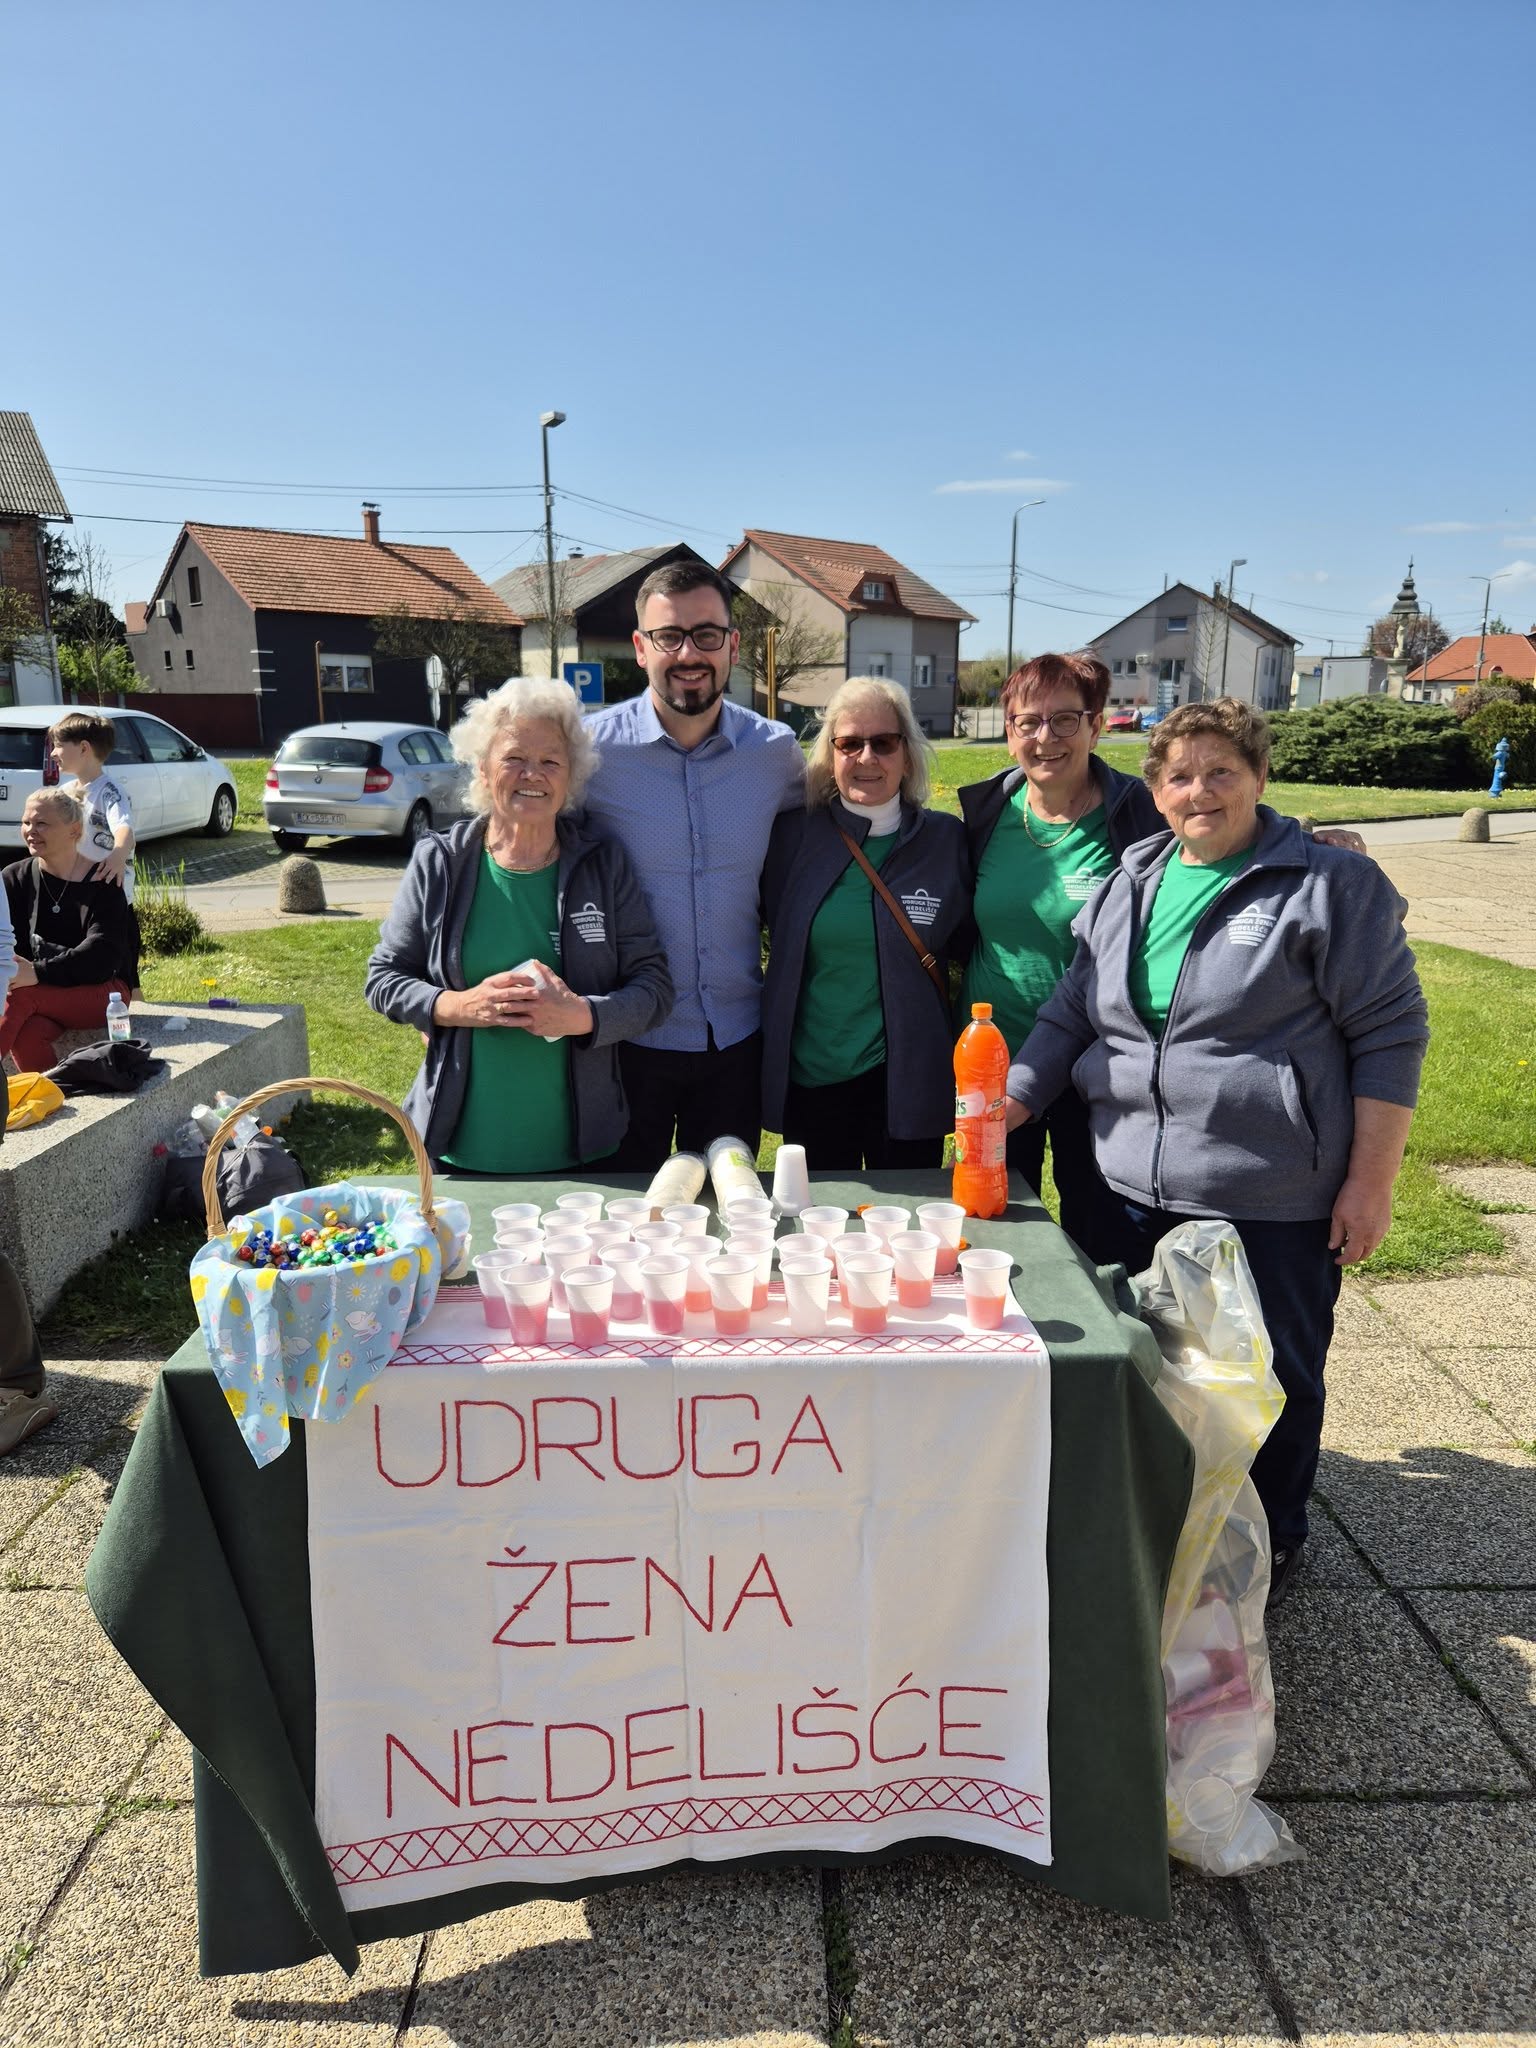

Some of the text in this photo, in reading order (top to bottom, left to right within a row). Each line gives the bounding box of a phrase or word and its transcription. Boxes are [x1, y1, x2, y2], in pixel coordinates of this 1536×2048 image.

[574, 670, 592, 700] P
[375, 1393, 843, 1488] UDRUGA
[487, 1546, 793, 1647] ŽENA
[386, 1673, 1008, 1818] NEDELIŠĆE
